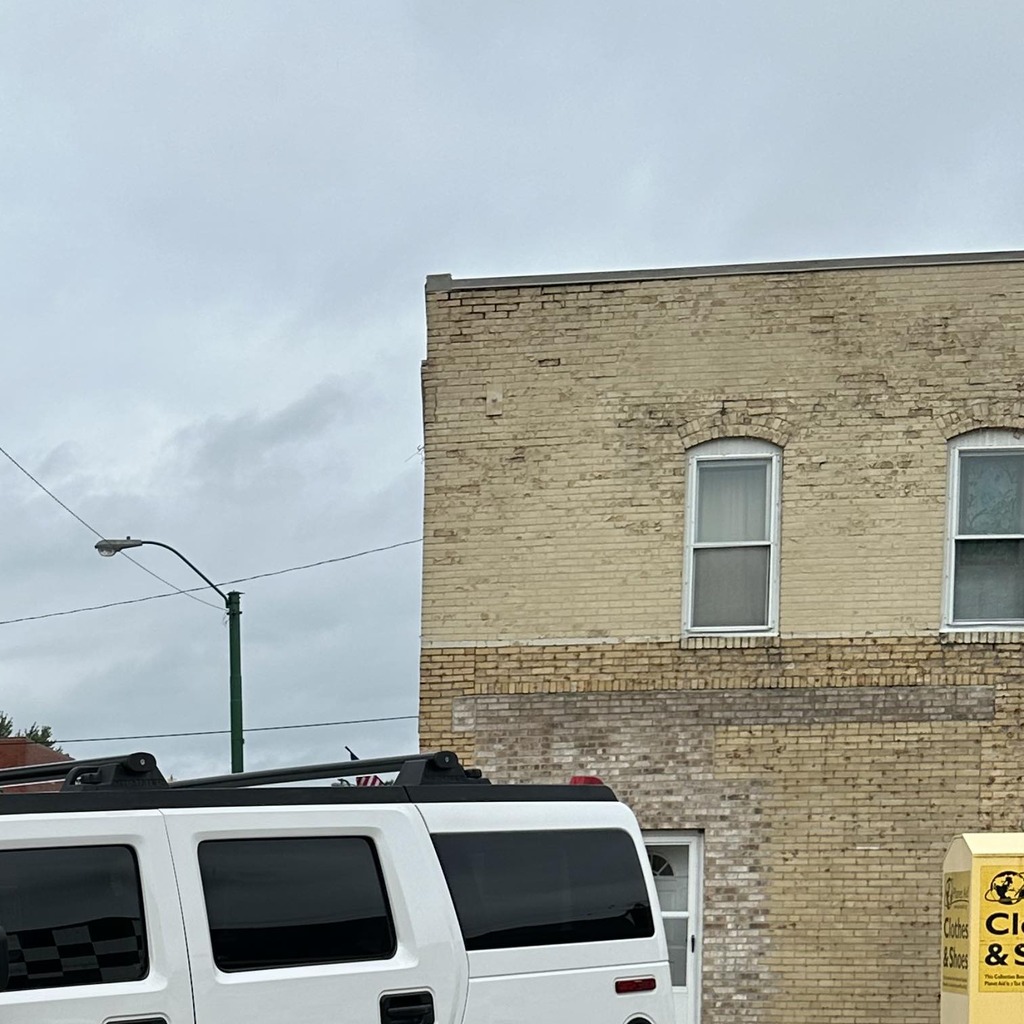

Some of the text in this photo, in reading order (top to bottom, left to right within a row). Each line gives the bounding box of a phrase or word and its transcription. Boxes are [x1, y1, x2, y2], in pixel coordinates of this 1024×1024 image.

[943, 917, 969, 940] Clothes
[985, 912, 1024, 936] Cl
[984, 943, 1009, 966] &
